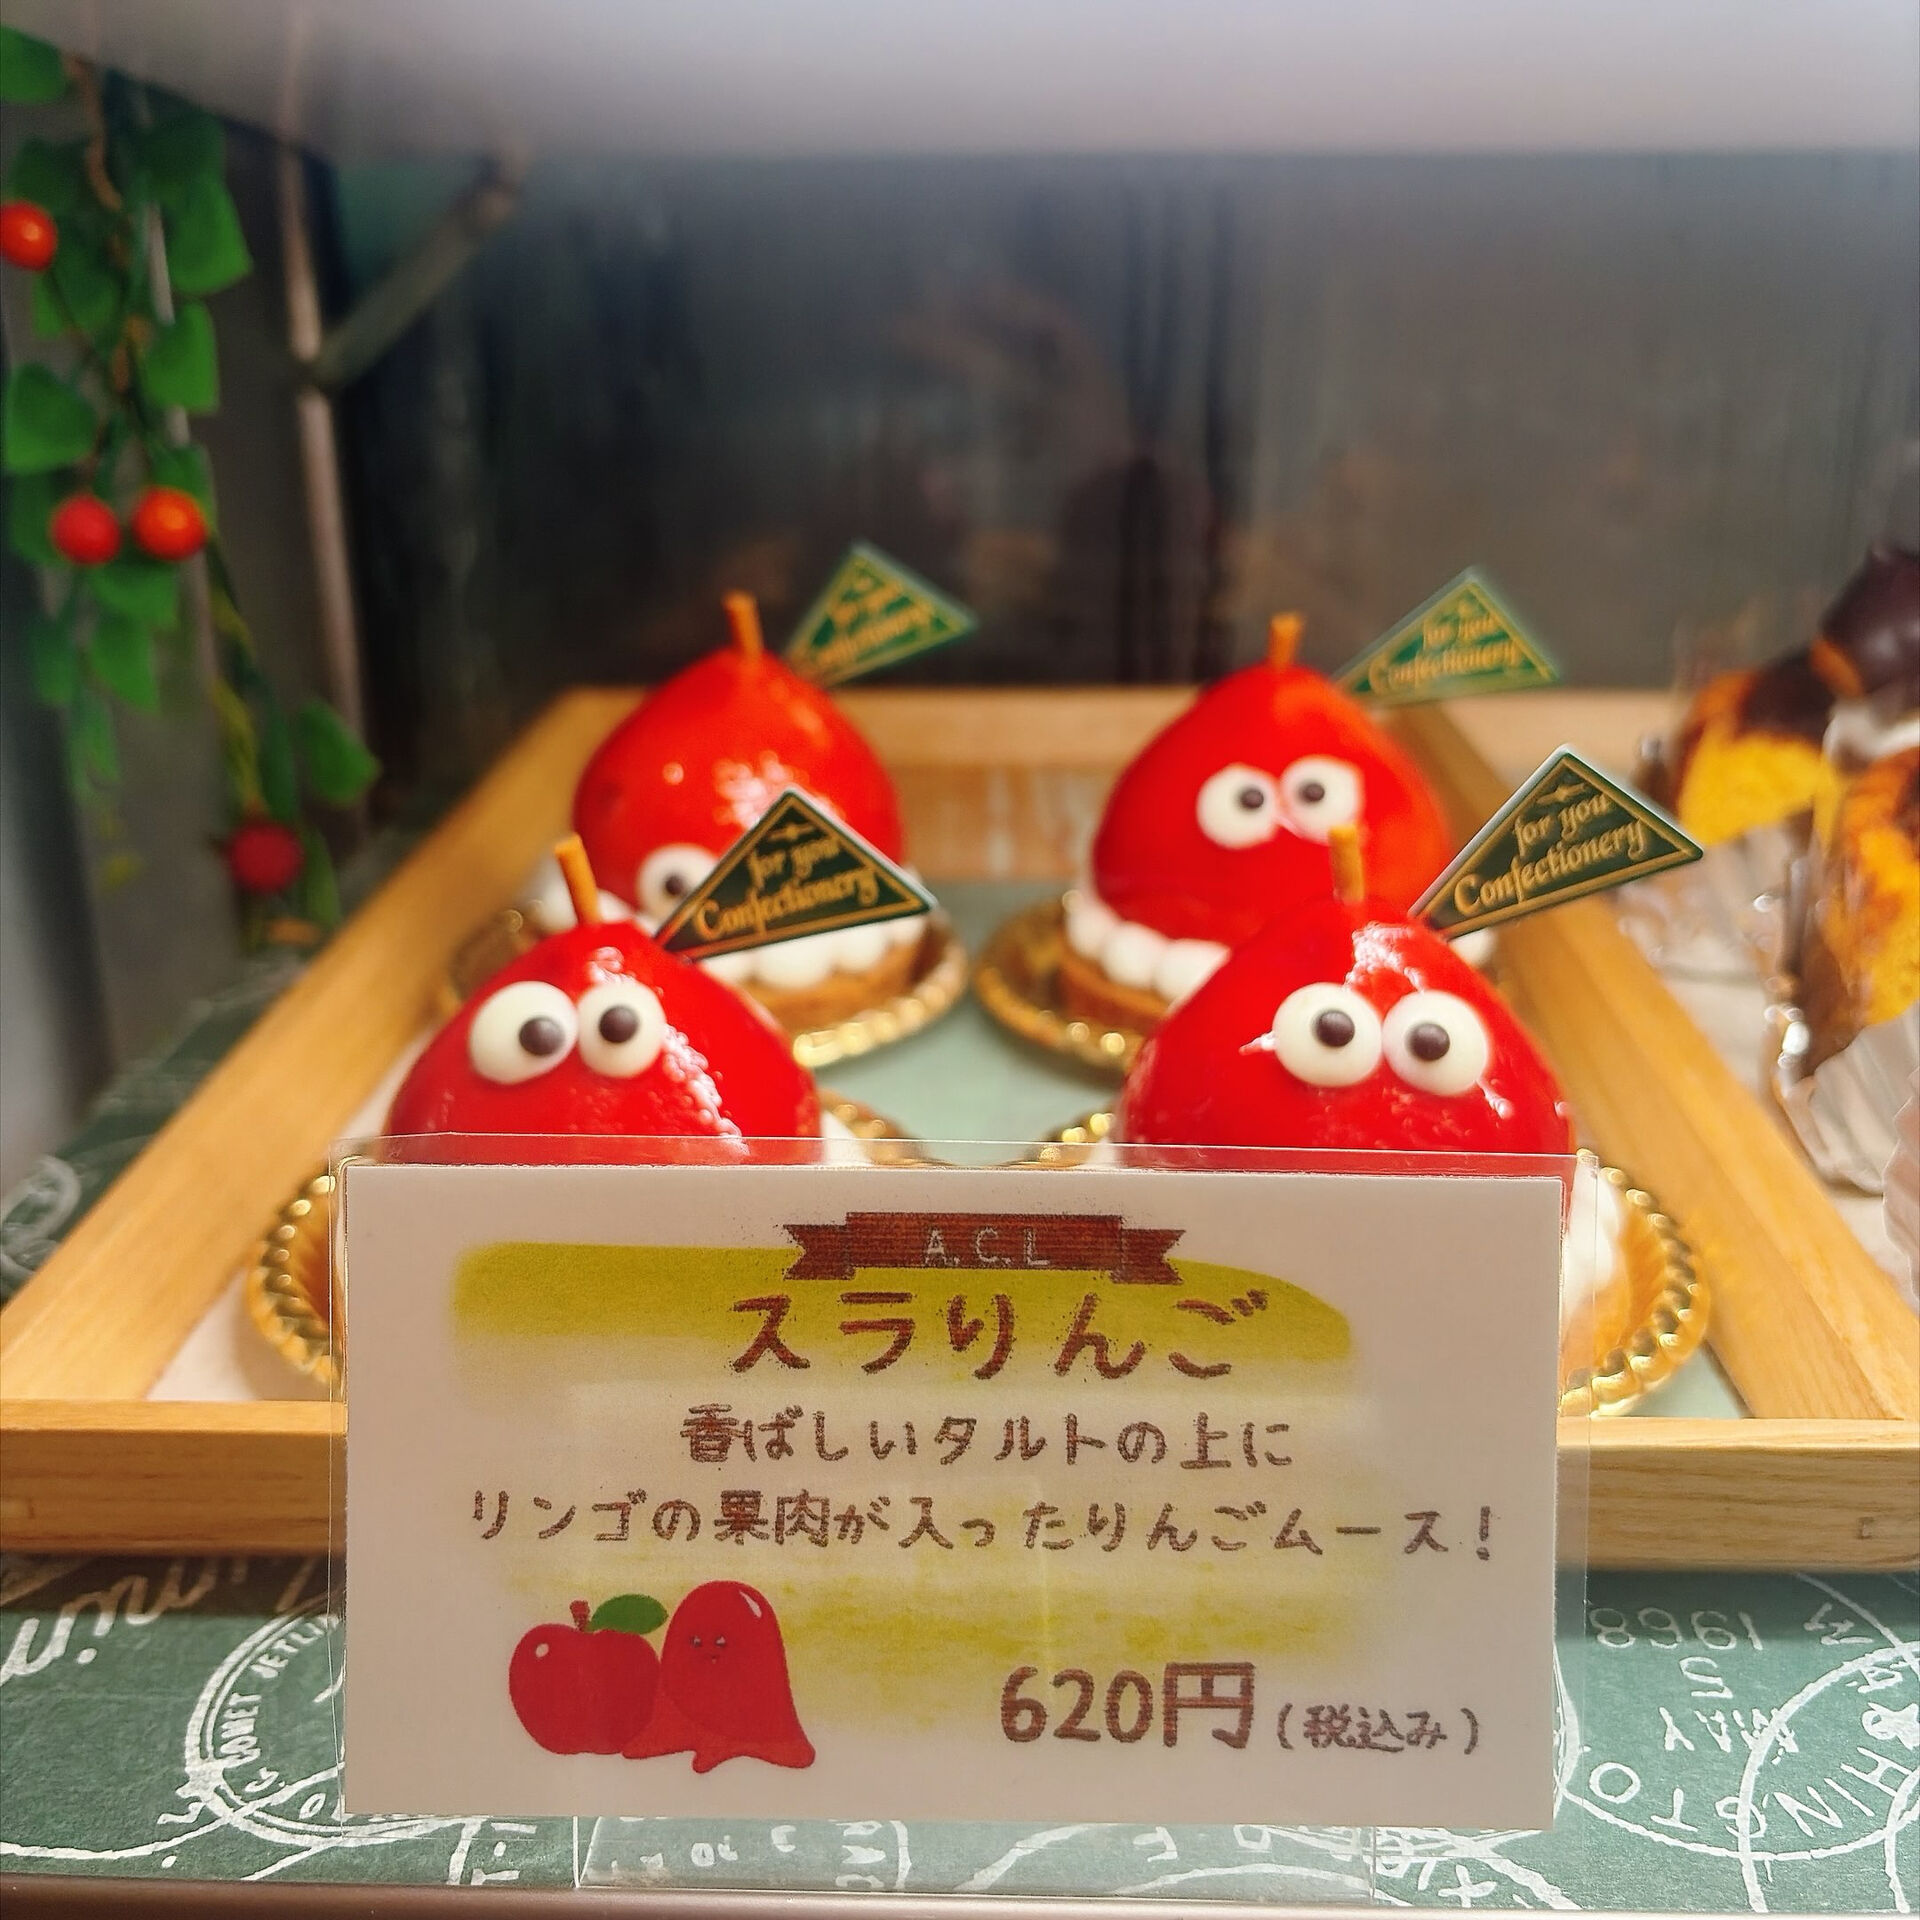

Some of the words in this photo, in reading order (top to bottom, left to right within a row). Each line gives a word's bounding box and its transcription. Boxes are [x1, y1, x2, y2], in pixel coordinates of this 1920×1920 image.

[1513, 813, 1551, 857] for
[1558, 794, 1611, 837] you
[692, 866, 879, 938] Confectionery
[1454, 818, 1648, 914] Confectionery
[729, 1290, 1270, 1380] スラりんご
[682, 1404, 1293, 1469] 香ばしいタルトの上に
[1000, 1661, 1256, 1749] 620円
